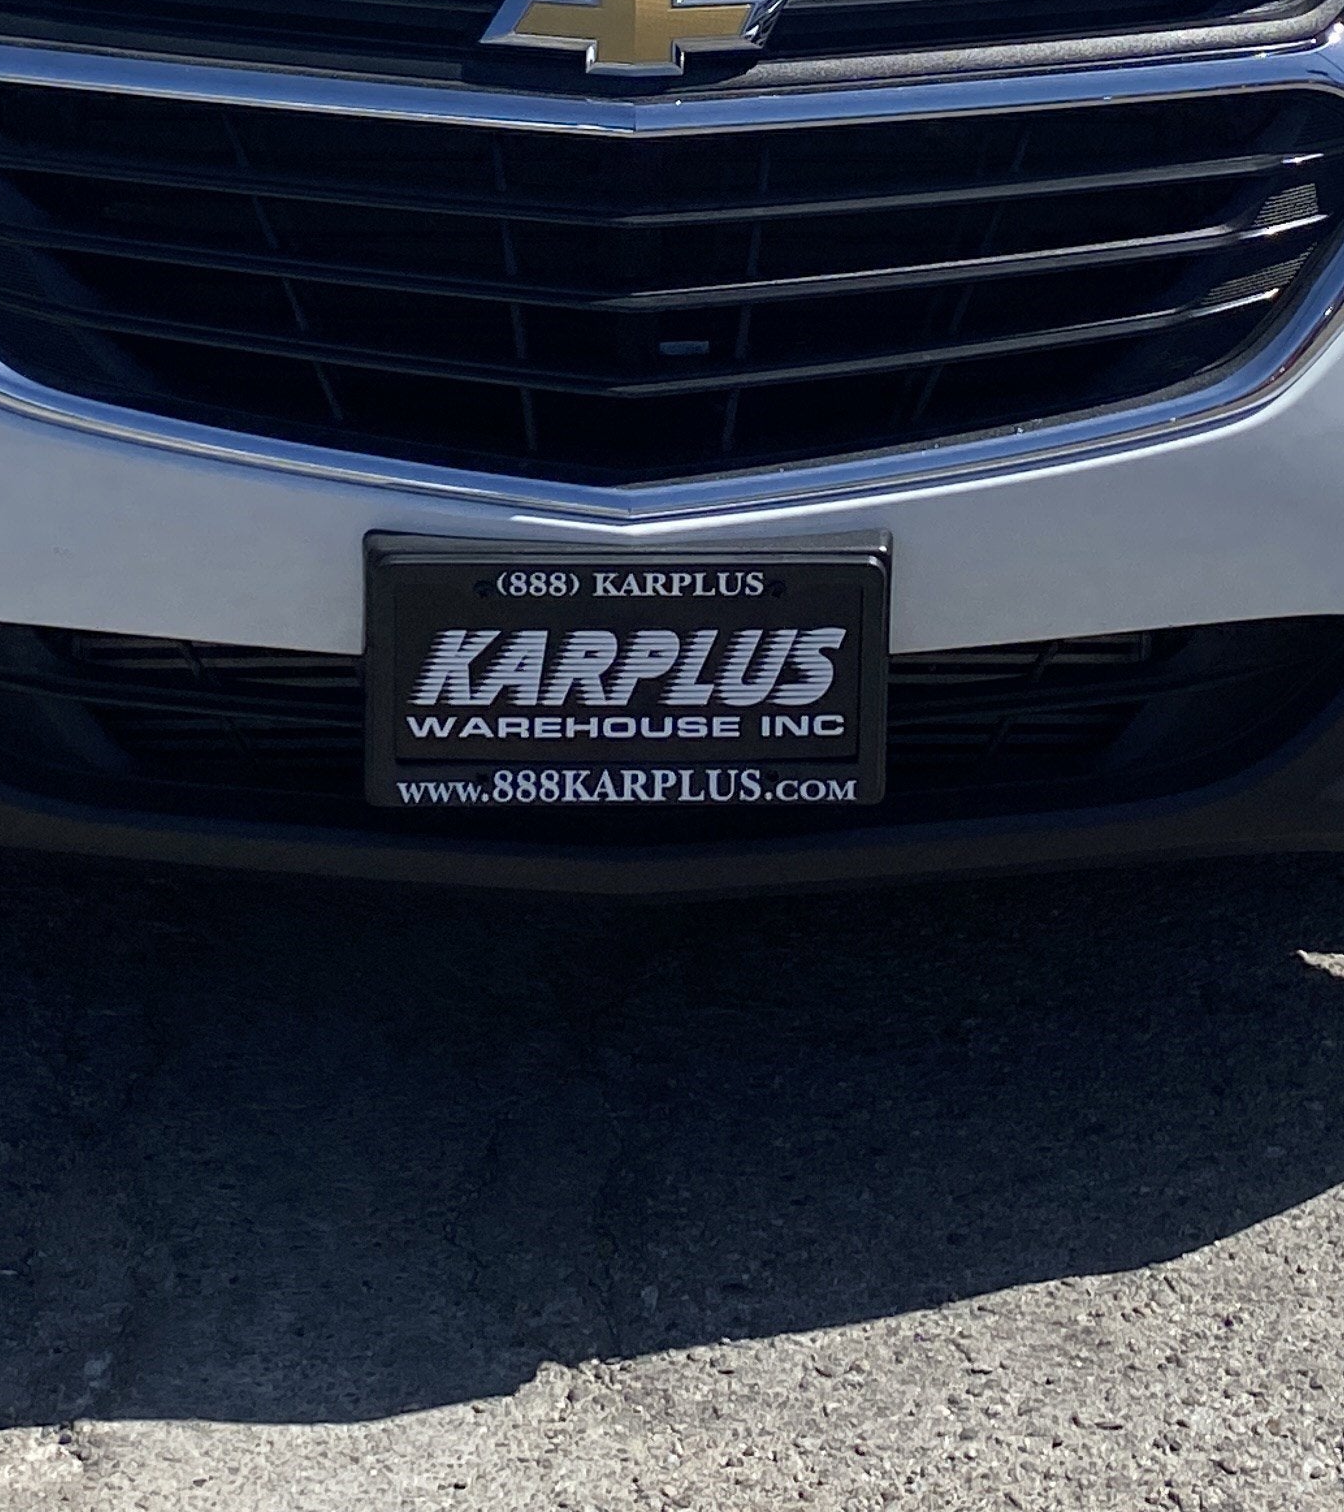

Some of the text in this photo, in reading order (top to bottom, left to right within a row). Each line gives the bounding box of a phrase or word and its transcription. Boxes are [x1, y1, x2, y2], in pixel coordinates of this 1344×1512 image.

[496, 571, 764, 598] (888) KARPLUS
[406, 626, 848, 707] KARPLUS
[406, 715, 844, 739] WAREHOUSE INC
